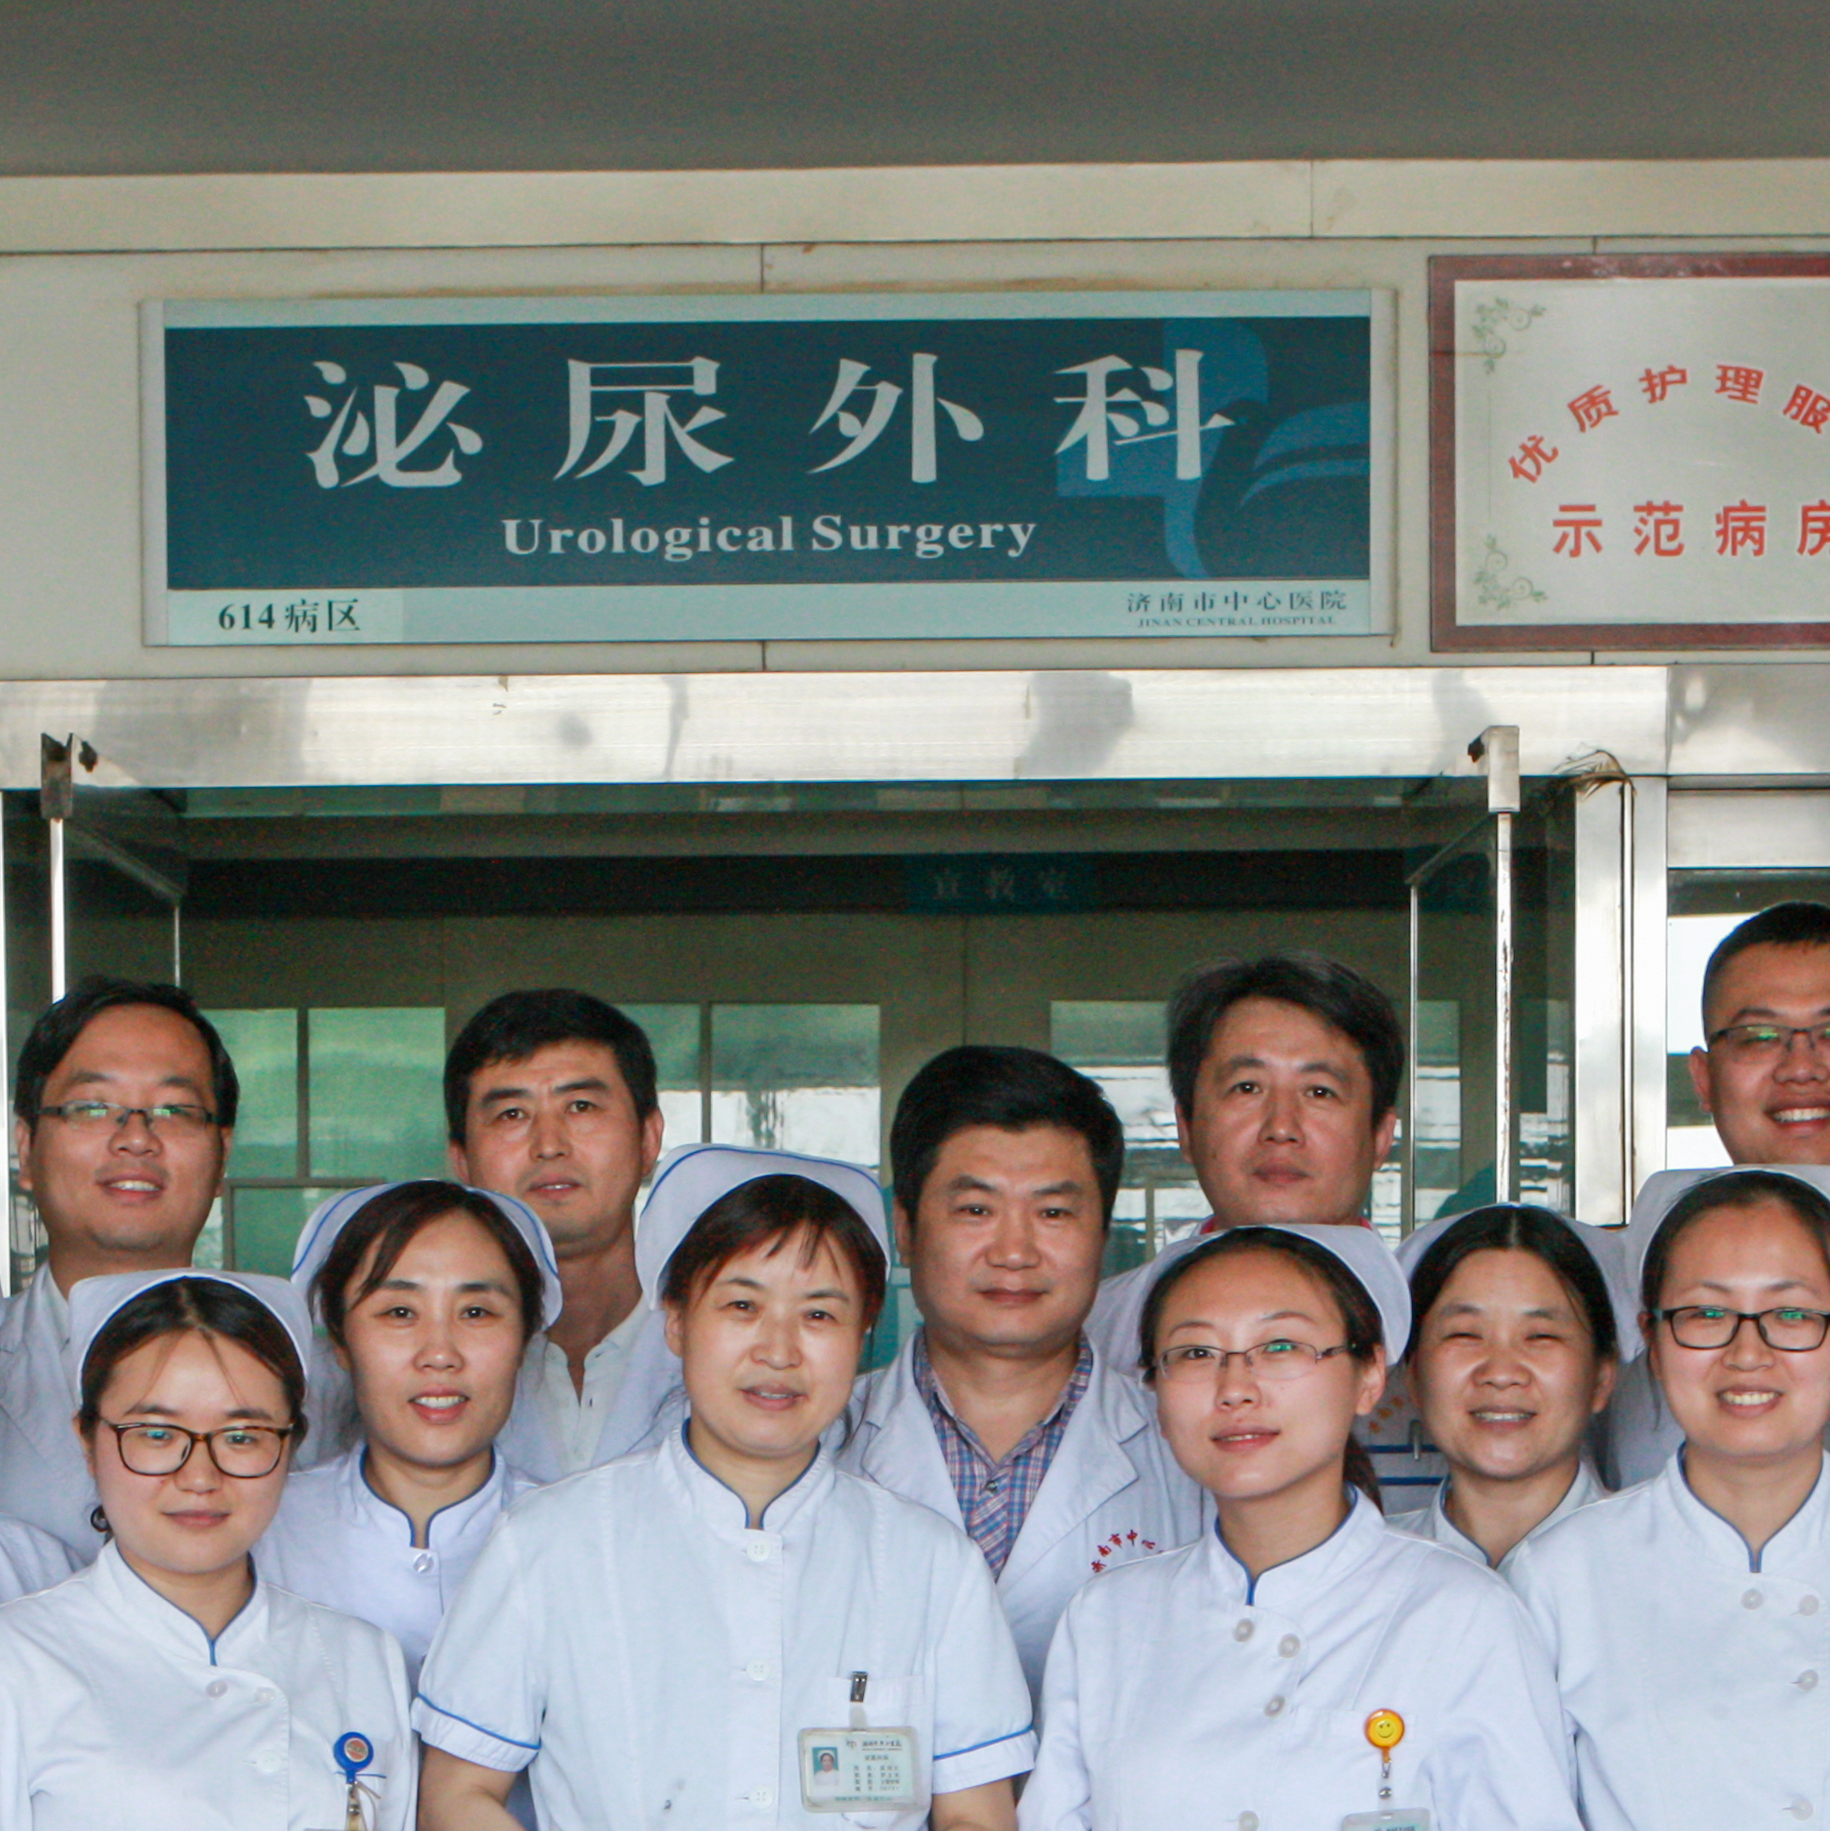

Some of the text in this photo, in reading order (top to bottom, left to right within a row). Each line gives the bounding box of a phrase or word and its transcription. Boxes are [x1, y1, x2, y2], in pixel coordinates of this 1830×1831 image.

[303, 348, 1237, 488] 泌尿外科
[501, 513, 1037, 562] Urological Surgery
[1127, 590, 1348, 613] 济南市中心医院
[1137, 615, 1337, 629] JINAN CENTRAL HOSPITAL
